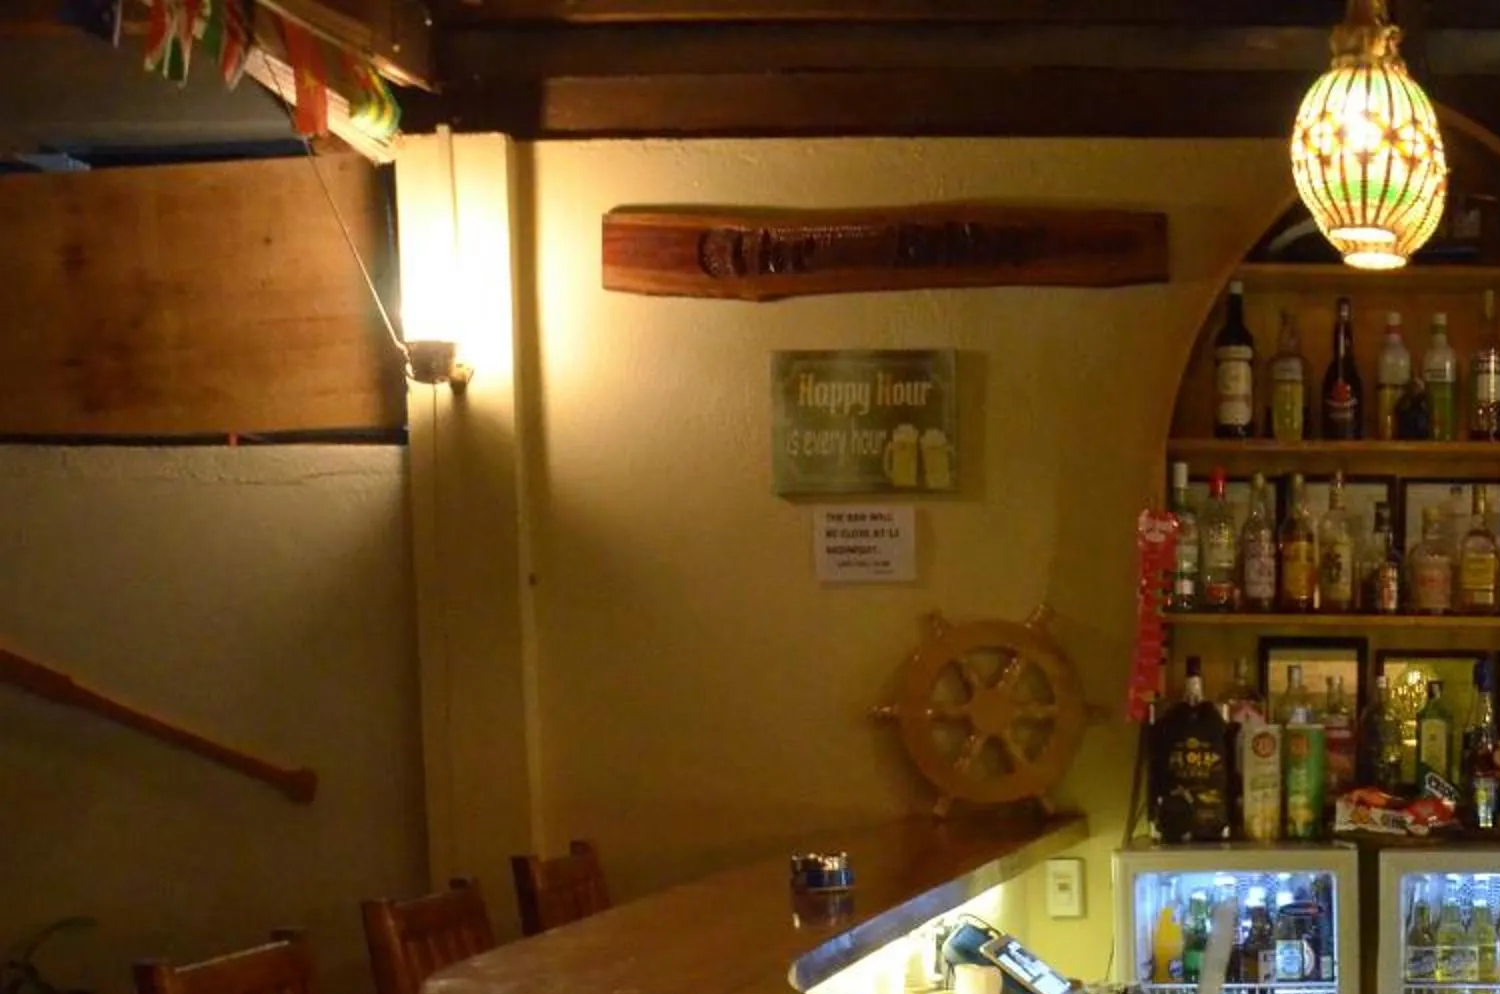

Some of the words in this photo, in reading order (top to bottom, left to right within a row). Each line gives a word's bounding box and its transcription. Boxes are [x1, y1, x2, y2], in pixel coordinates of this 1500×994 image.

[798, 371, 871, 416] Happy
[877, 370, 933, 407] Hour
[851, 416, 887, 456] hour
